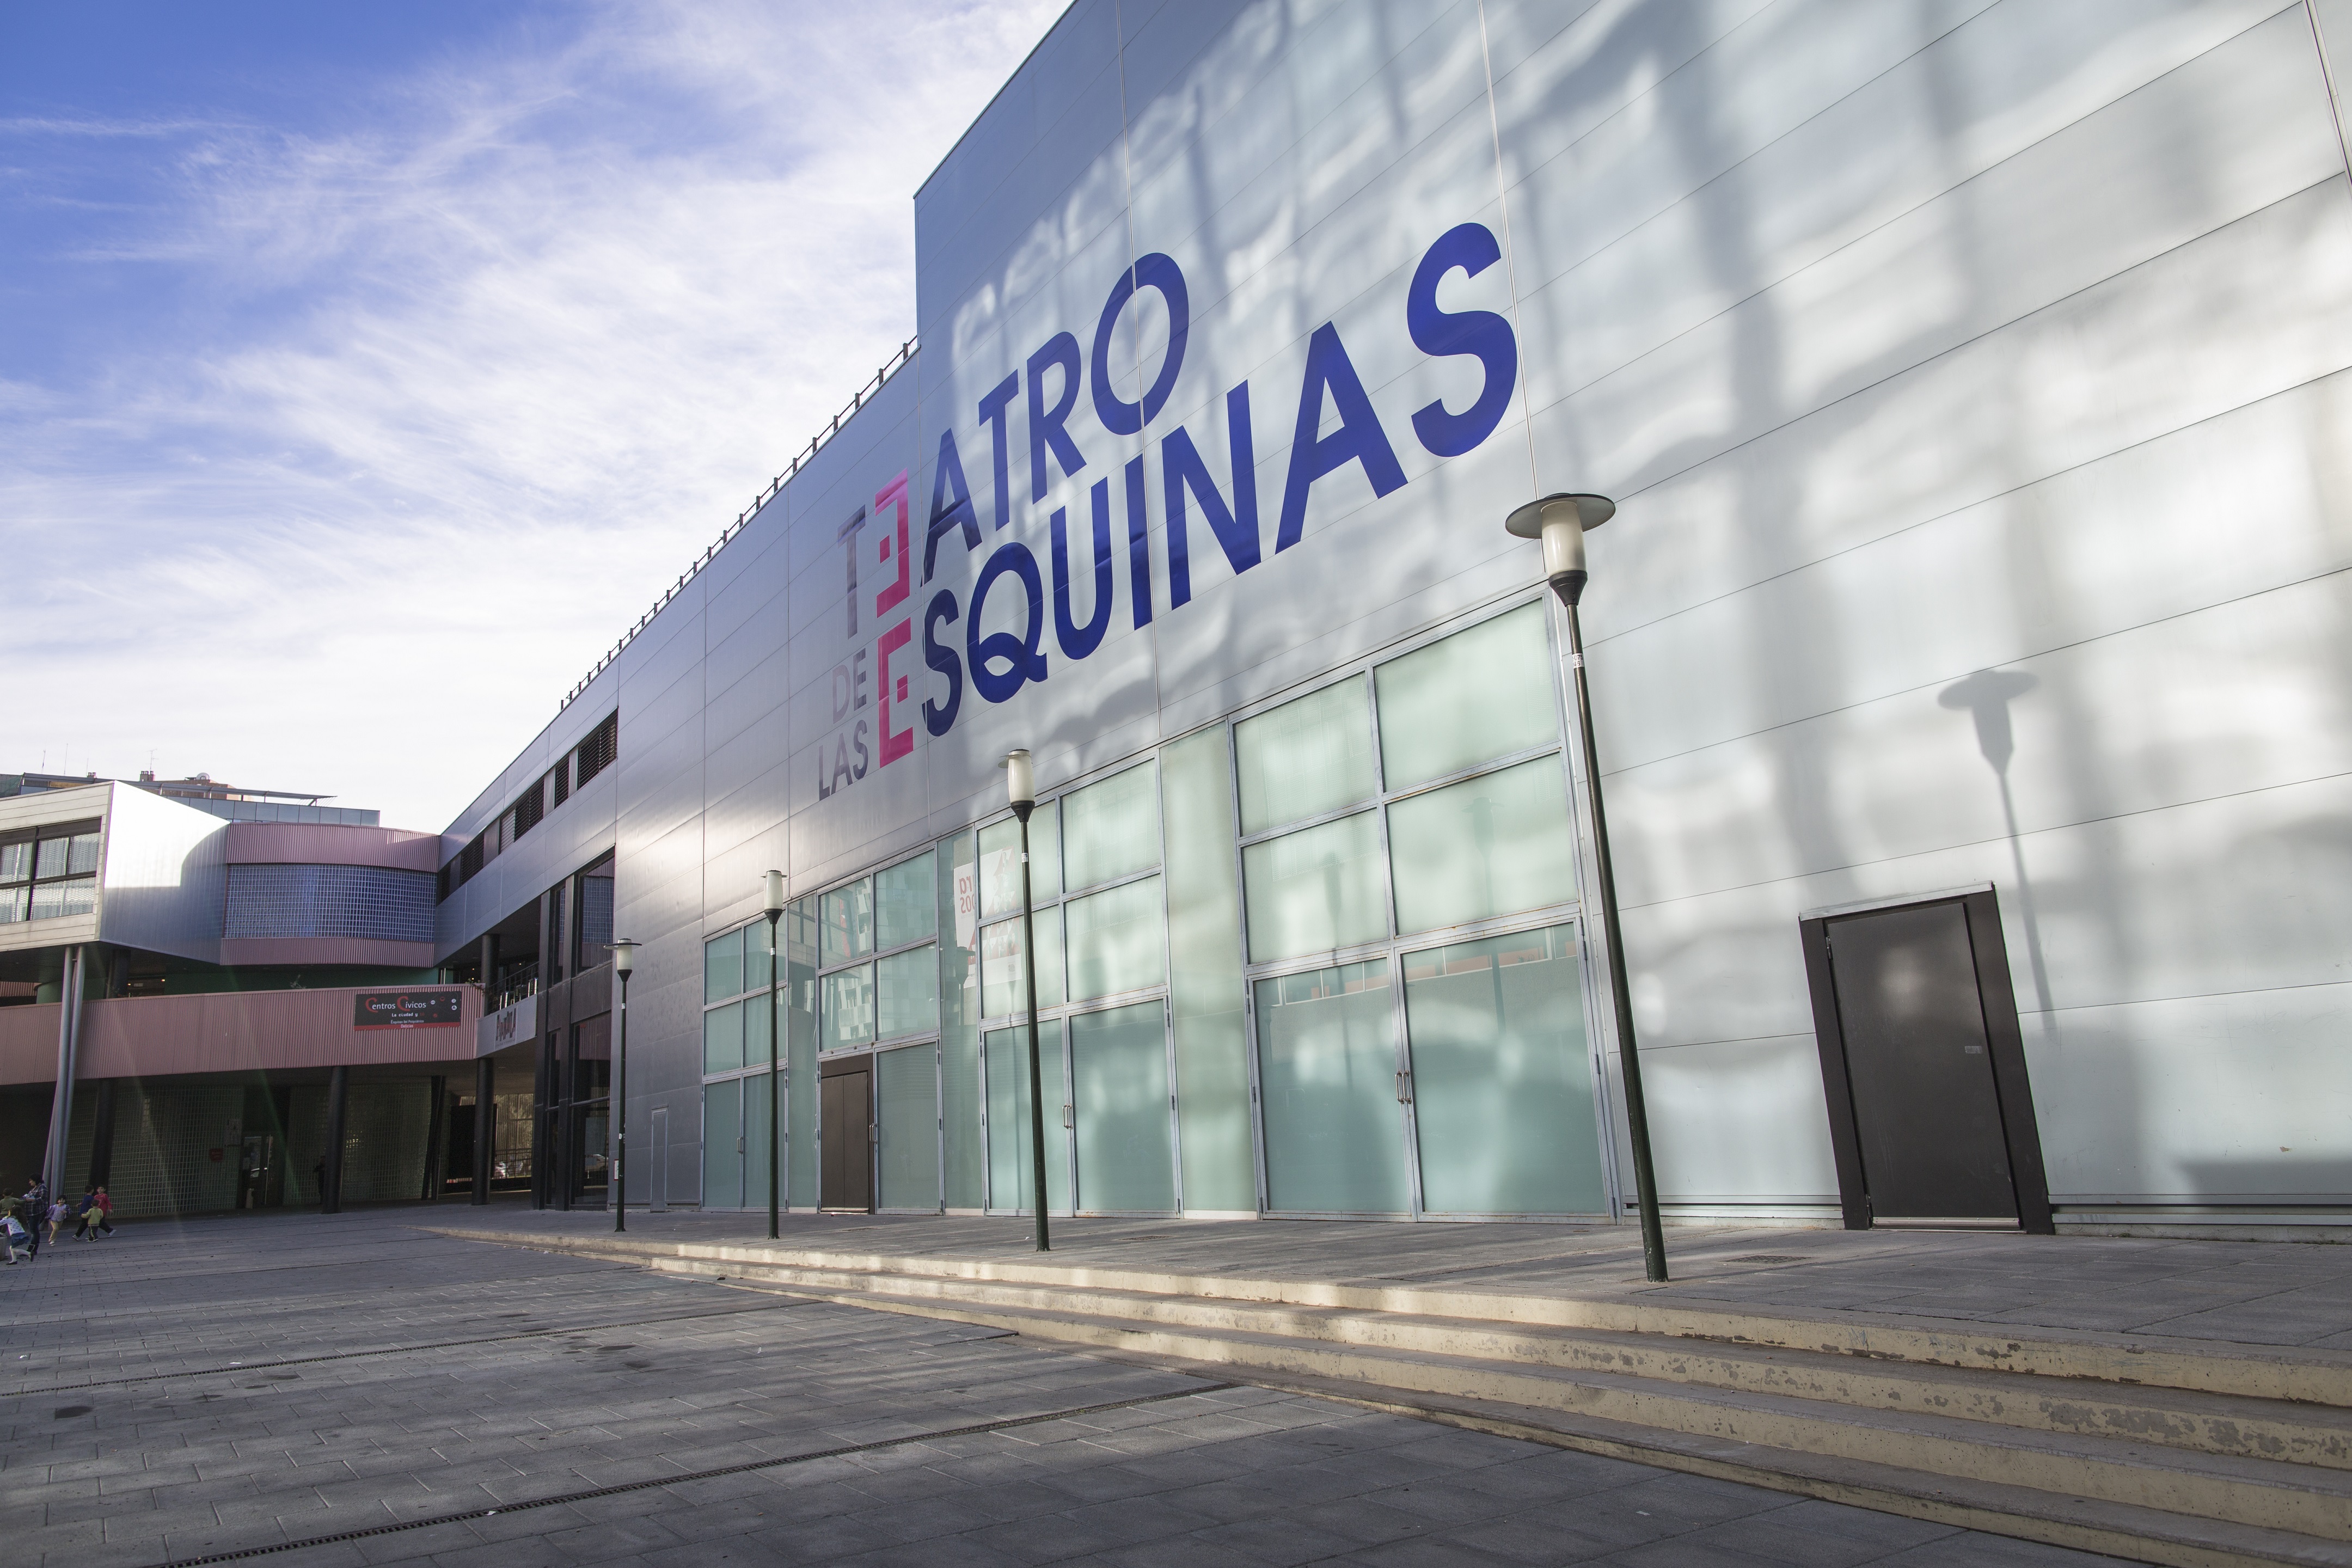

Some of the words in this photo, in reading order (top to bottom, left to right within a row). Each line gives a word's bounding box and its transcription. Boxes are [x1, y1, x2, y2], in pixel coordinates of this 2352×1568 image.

[838, 253, 1190, 640] TEATRO
[878, 222, 1517, 769] ESQUINAS
[832, 648, 867, 724] DE
[818, 719, 868, 801] LAS
[365, 997, 396, 1013] Centros
[396, 996, 426, 1012] Cívicos
